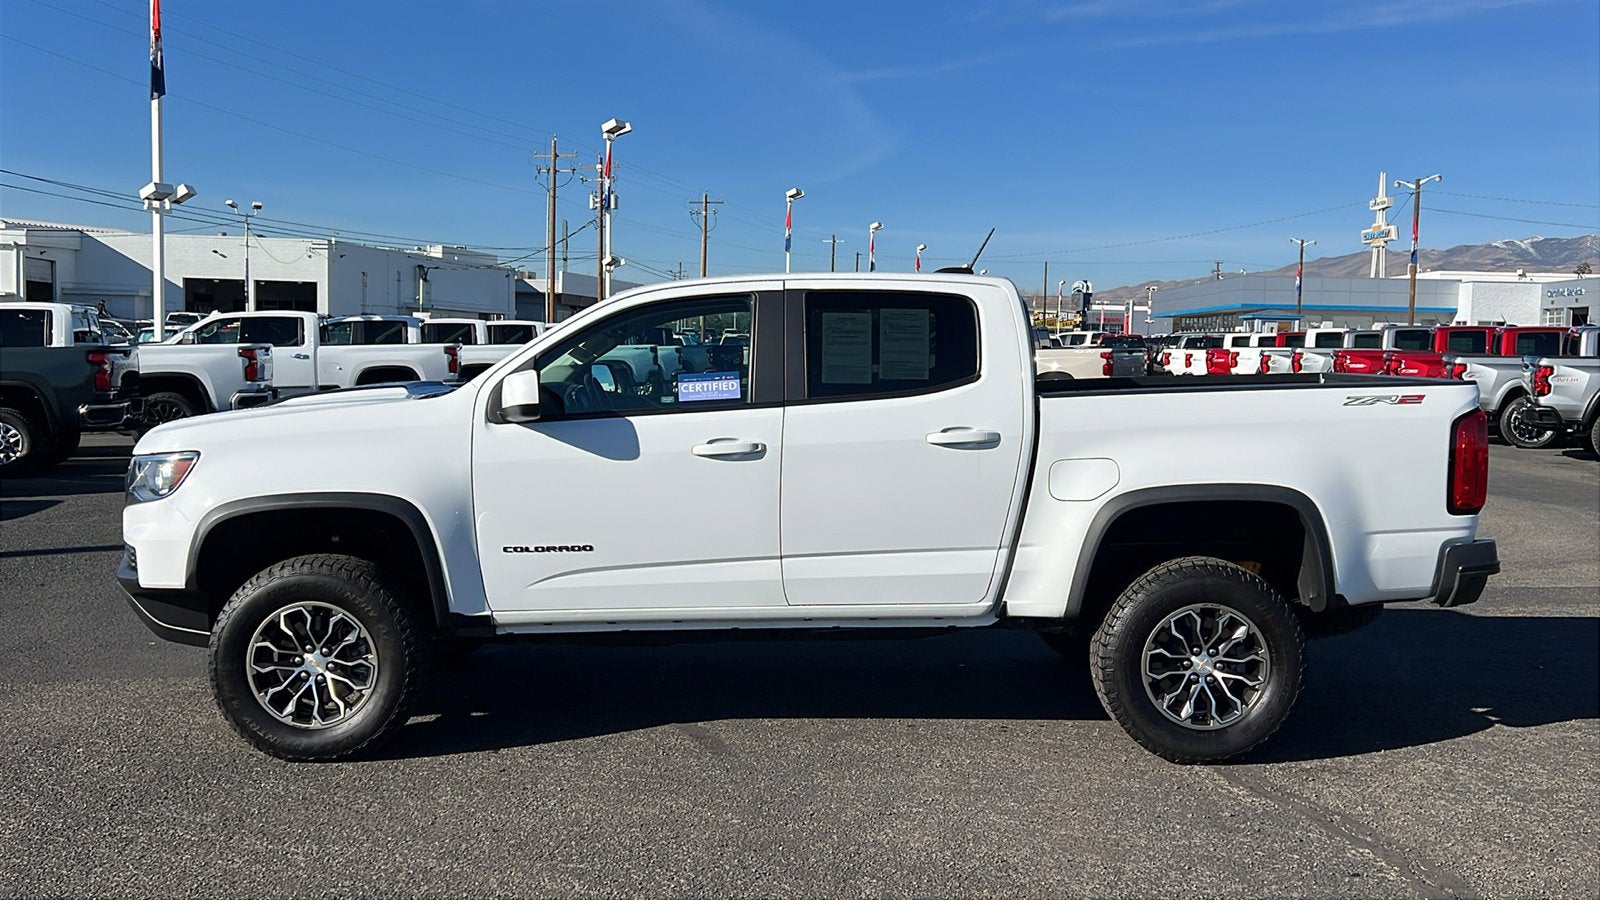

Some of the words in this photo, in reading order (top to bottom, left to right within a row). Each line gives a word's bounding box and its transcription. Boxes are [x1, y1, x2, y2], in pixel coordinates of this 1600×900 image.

[681, 381, 737, 392] CERTIFIED
[1342, 394, 1426, 406] ZR2
[502, 545, 594, 553] COLORADO
